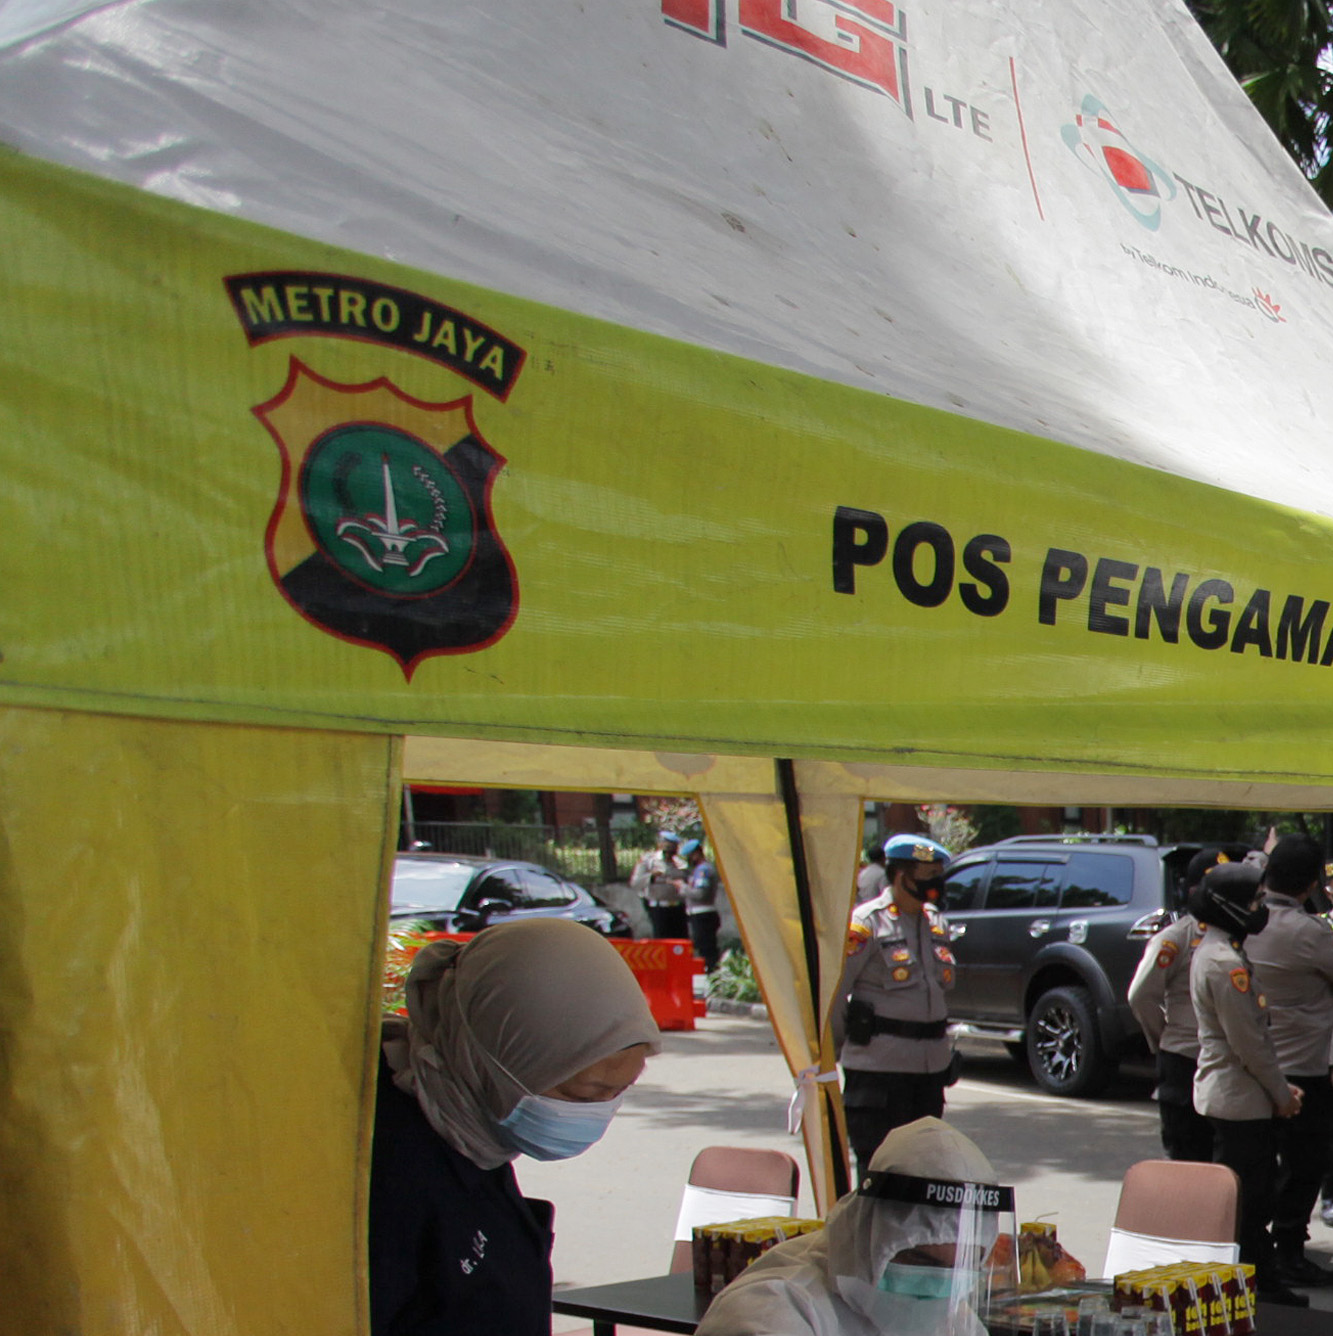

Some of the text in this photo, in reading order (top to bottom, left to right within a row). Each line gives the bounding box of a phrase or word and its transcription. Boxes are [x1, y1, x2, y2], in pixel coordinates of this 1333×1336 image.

[923, 86, 994, 144] LTE
[240, 284, 508, 382] METRO JAYA
[832, 505, 1012, 618] POS
[925, 1183, 1001, 1207] PUSDOKKES
